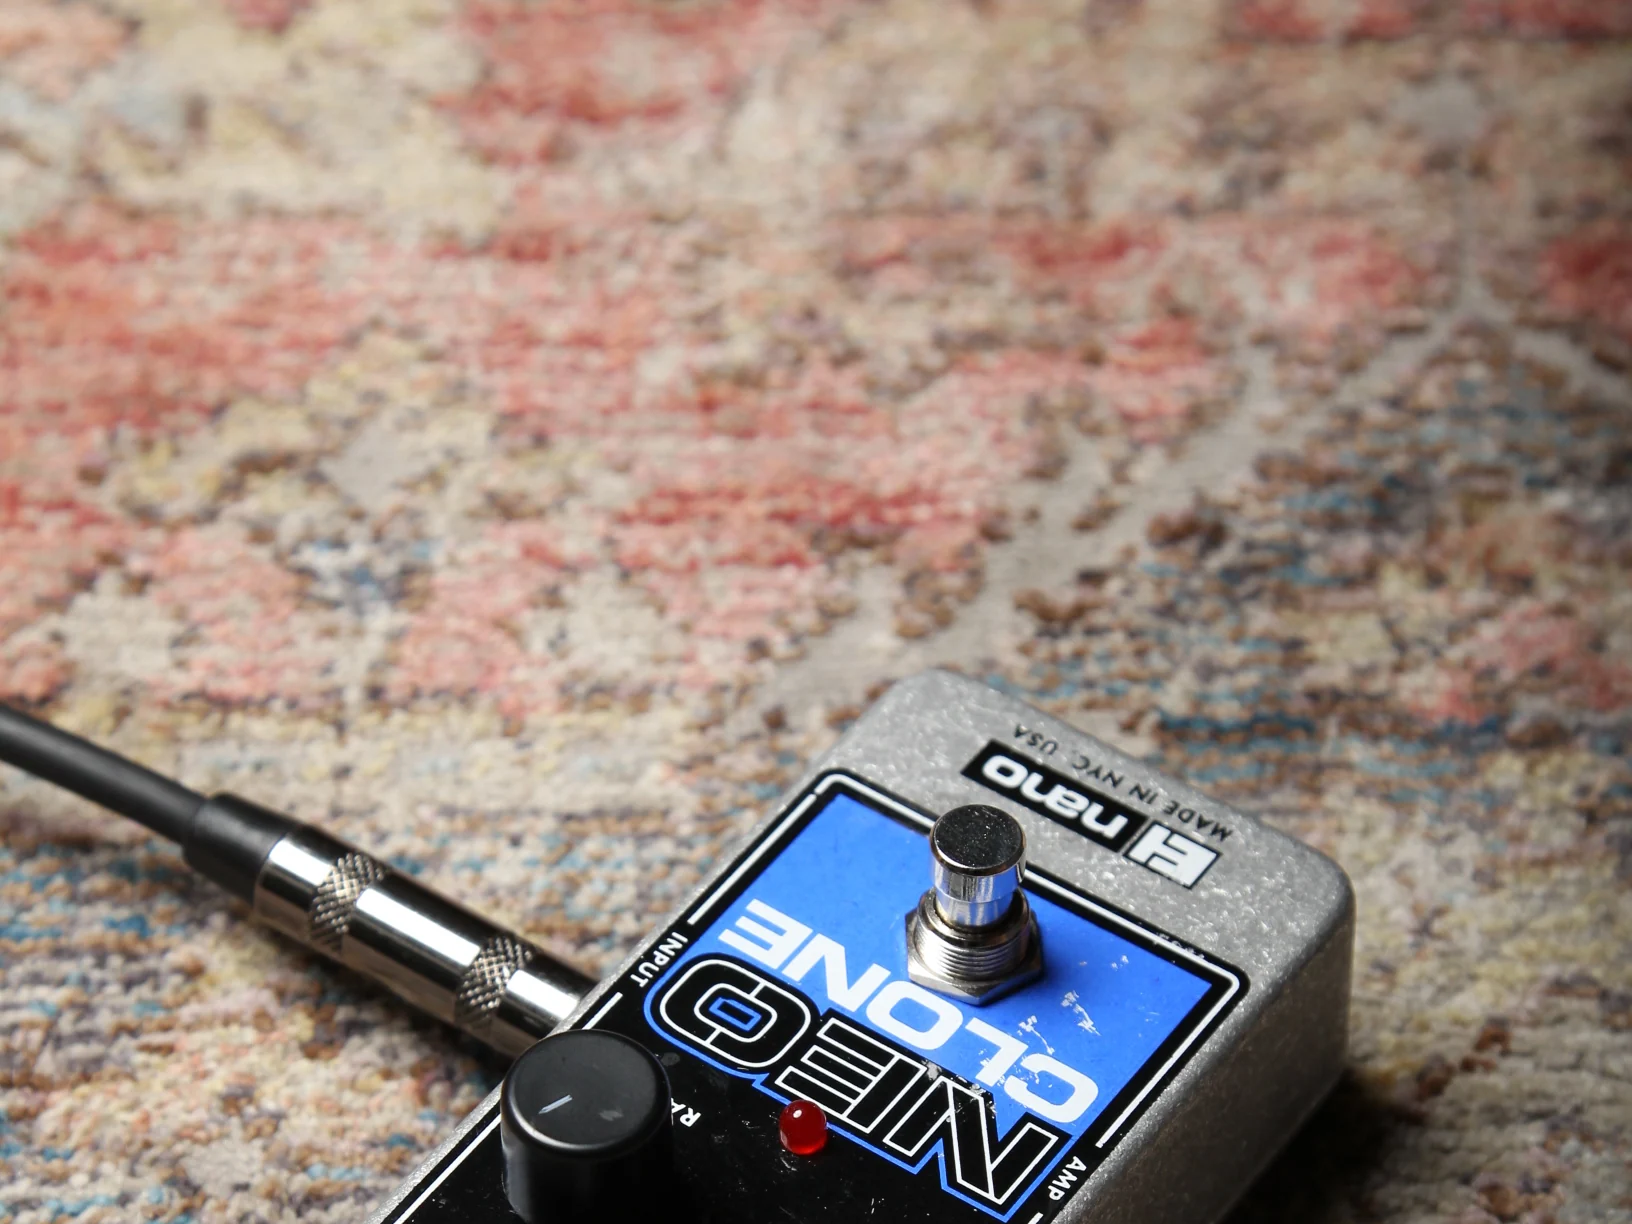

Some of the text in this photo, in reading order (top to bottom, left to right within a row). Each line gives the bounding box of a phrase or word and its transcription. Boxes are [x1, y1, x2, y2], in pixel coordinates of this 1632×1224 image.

[1013, 724, 1060, 756] USA
[980, 754, 1130, 840] nano
[1128, 783, 1159, 805] IN
[1163, 800, 1234, 842] MADE
[630, 931, 689, 988] INPUT
[718, 898, 1100, 1124] CLONE
[658, 957, 1061, 1207] NEO
[671, 1097, 702, 1128] RA
[1047, 1155, 1088, 1201] AMP
